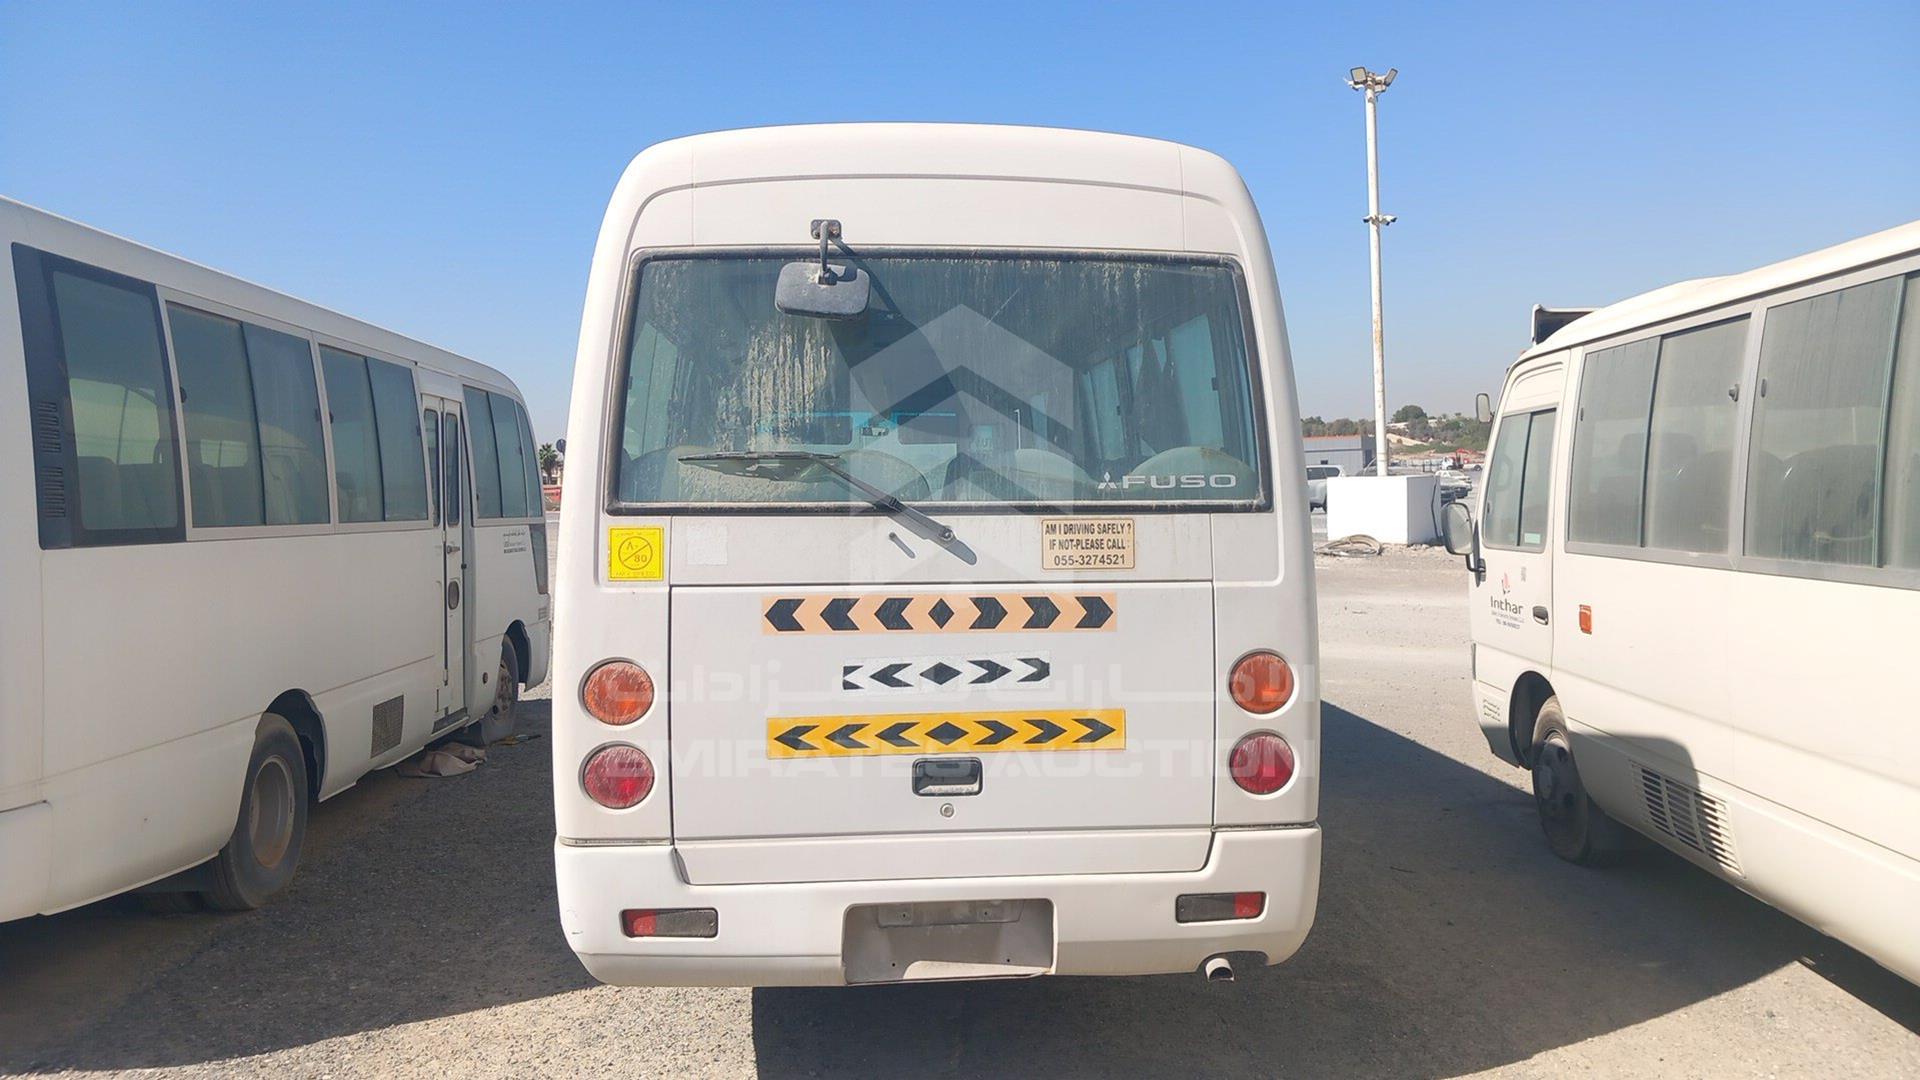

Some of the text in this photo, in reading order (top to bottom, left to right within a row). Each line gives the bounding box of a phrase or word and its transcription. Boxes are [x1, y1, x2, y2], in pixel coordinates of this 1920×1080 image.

[1122, 474, 1237, 489] FUSO
[1045, 524, 1057, 536] AM
[1063, 524, 1095, 535] DRIVING
[1097, 523, 1125, 534] SAFELY
[1049, 539, 1056, 550] IF
[634, 554, 648, 563] 80
[1054, 553, 1125, 566] 055-3274521
[1490, 595, 1523, 615] Inthar
